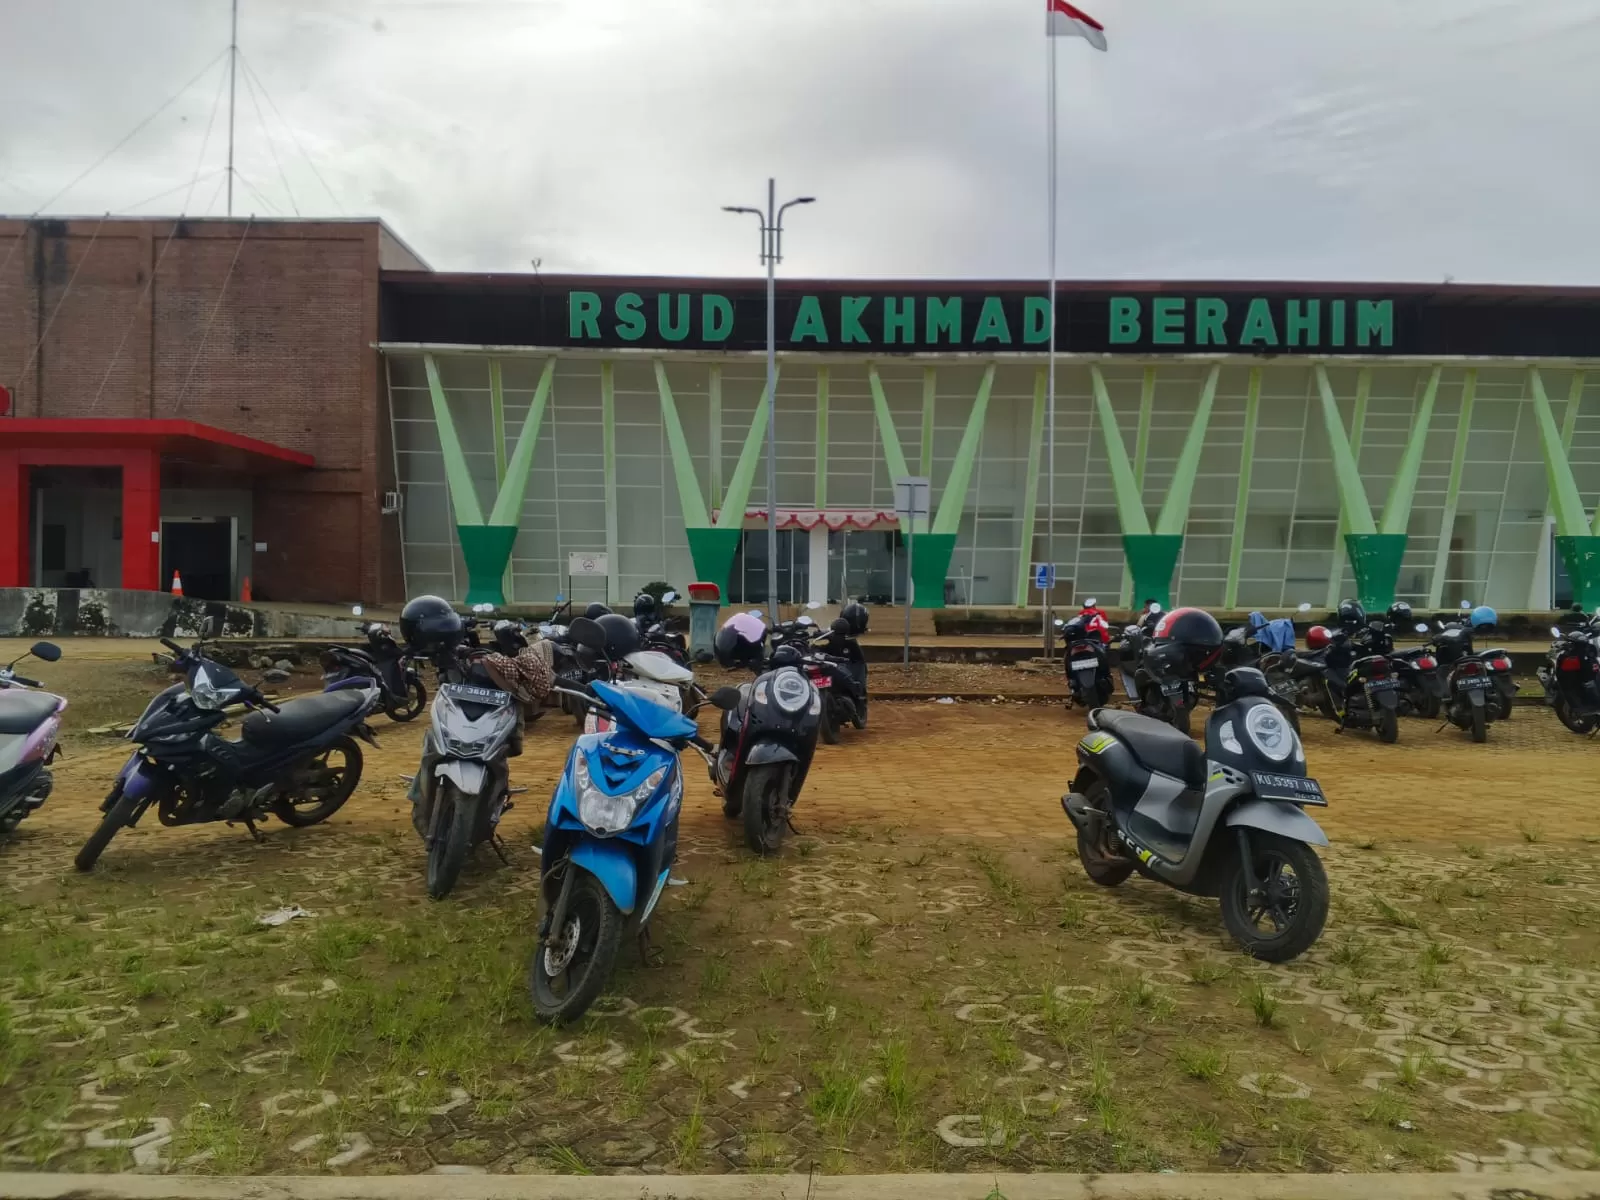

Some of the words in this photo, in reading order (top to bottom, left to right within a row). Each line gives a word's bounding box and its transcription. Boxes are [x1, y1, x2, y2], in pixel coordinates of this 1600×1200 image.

[568, 291, 735, 341] RSUD
[791, 294, 1055, 343] AKHMAD
[1109, 297, 1394, 346] BERAHIM
